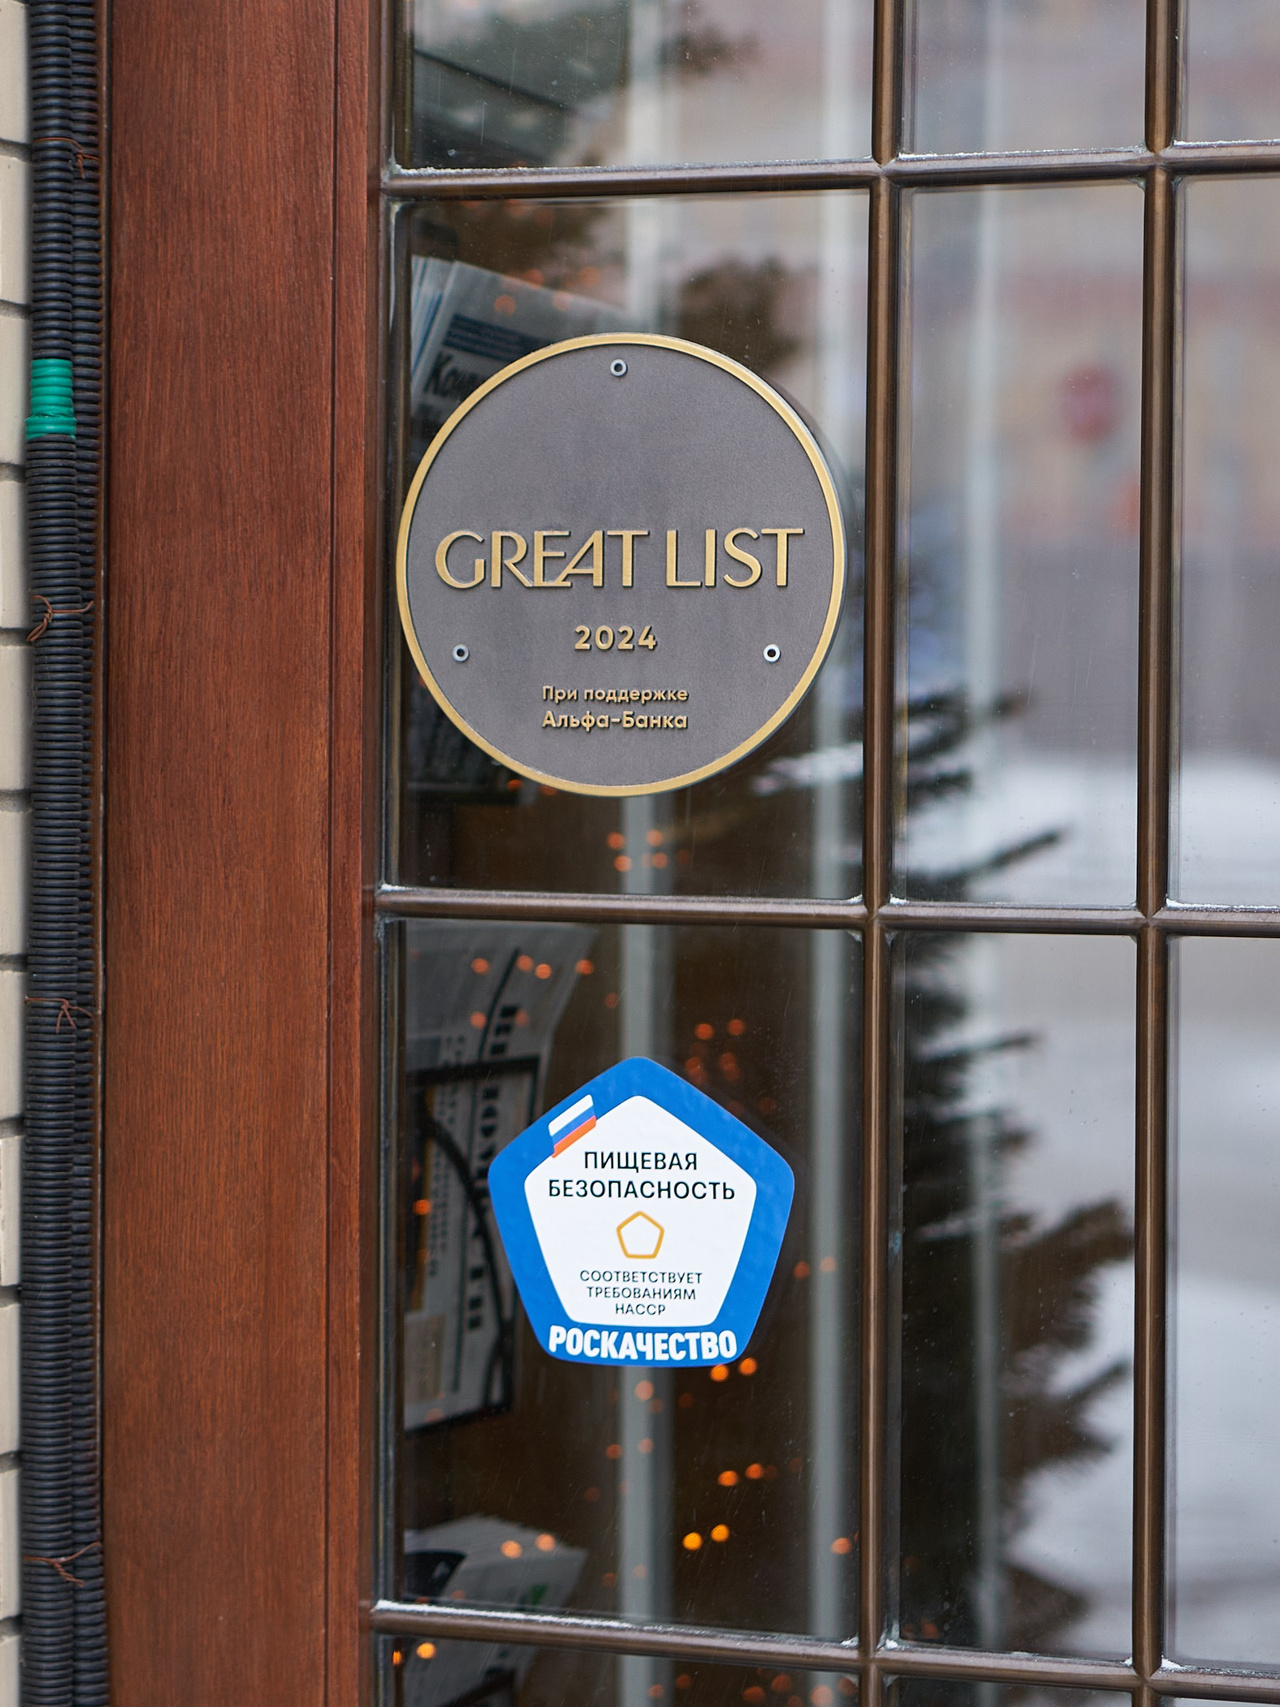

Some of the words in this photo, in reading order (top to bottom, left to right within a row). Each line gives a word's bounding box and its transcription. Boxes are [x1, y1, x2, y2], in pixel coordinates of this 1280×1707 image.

[435, 529, 650, 590] GREAT
[665, 527, 805, 588] LIST
[573, 624, 658, 651] 2024
[542, 685, 578, 704] При
[583, 687, 689, 704] поддержке
[542, 710, 689, 732] Альфа-Банка
[583, 1151, 698, 1173] ПИЩЕВАЯ
[548, 1179, 736, 1201] БЕЗОПАСНОСТЬ
[579, 1269, 703, 1285] СООТВЕТСТВУЕТ
[586, 1285, 697, 1300] ТРЕБОВАНИЯМ
[548, 1324, 738, 1361] РОСКАЧЕСТВО
